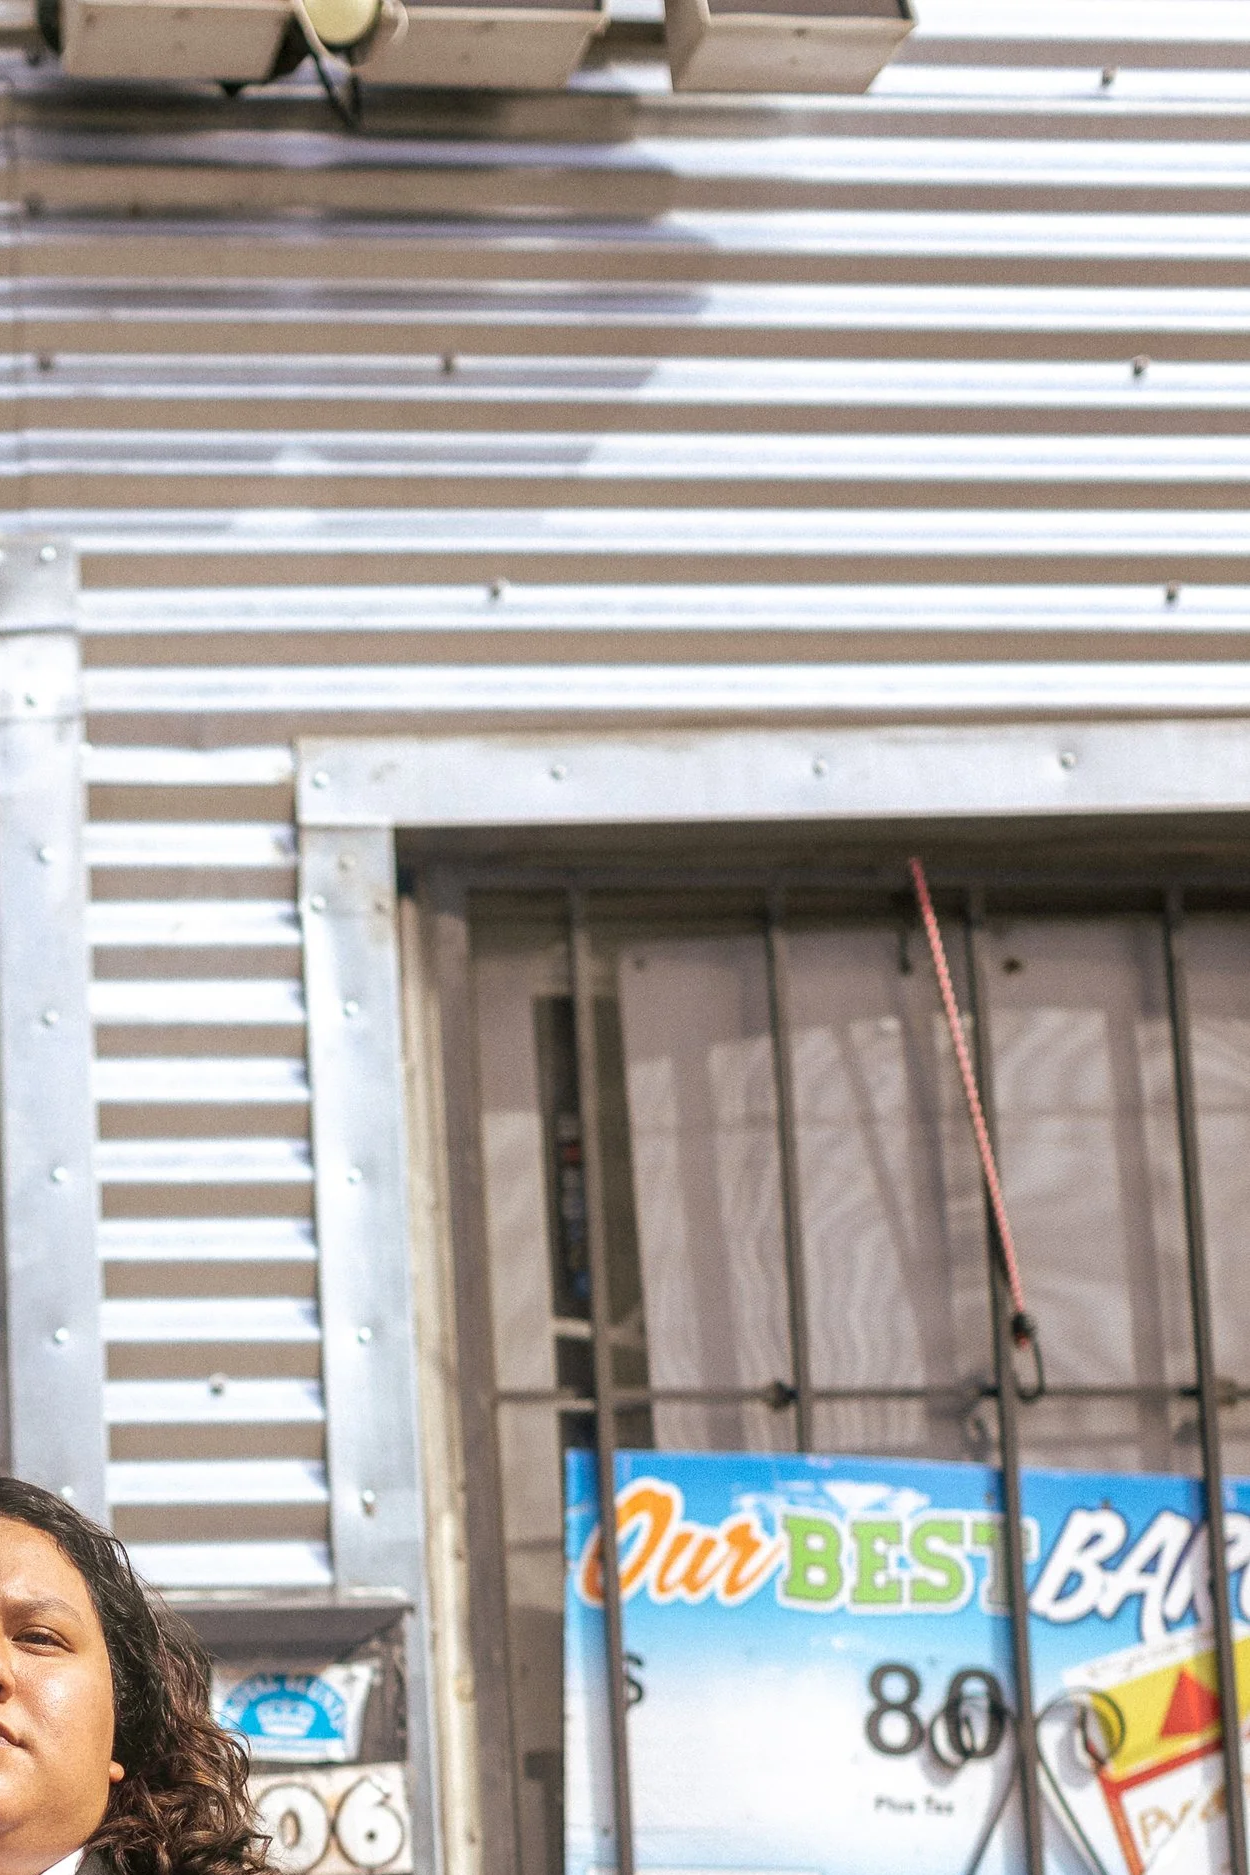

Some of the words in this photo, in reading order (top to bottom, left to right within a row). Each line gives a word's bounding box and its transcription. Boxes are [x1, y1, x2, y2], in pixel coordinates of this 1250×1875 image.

[578, 1482, 782, 1605] Our
[780, 1513, 1036, 1610] BEST
[864, 1661, 1007, 1760] 80
